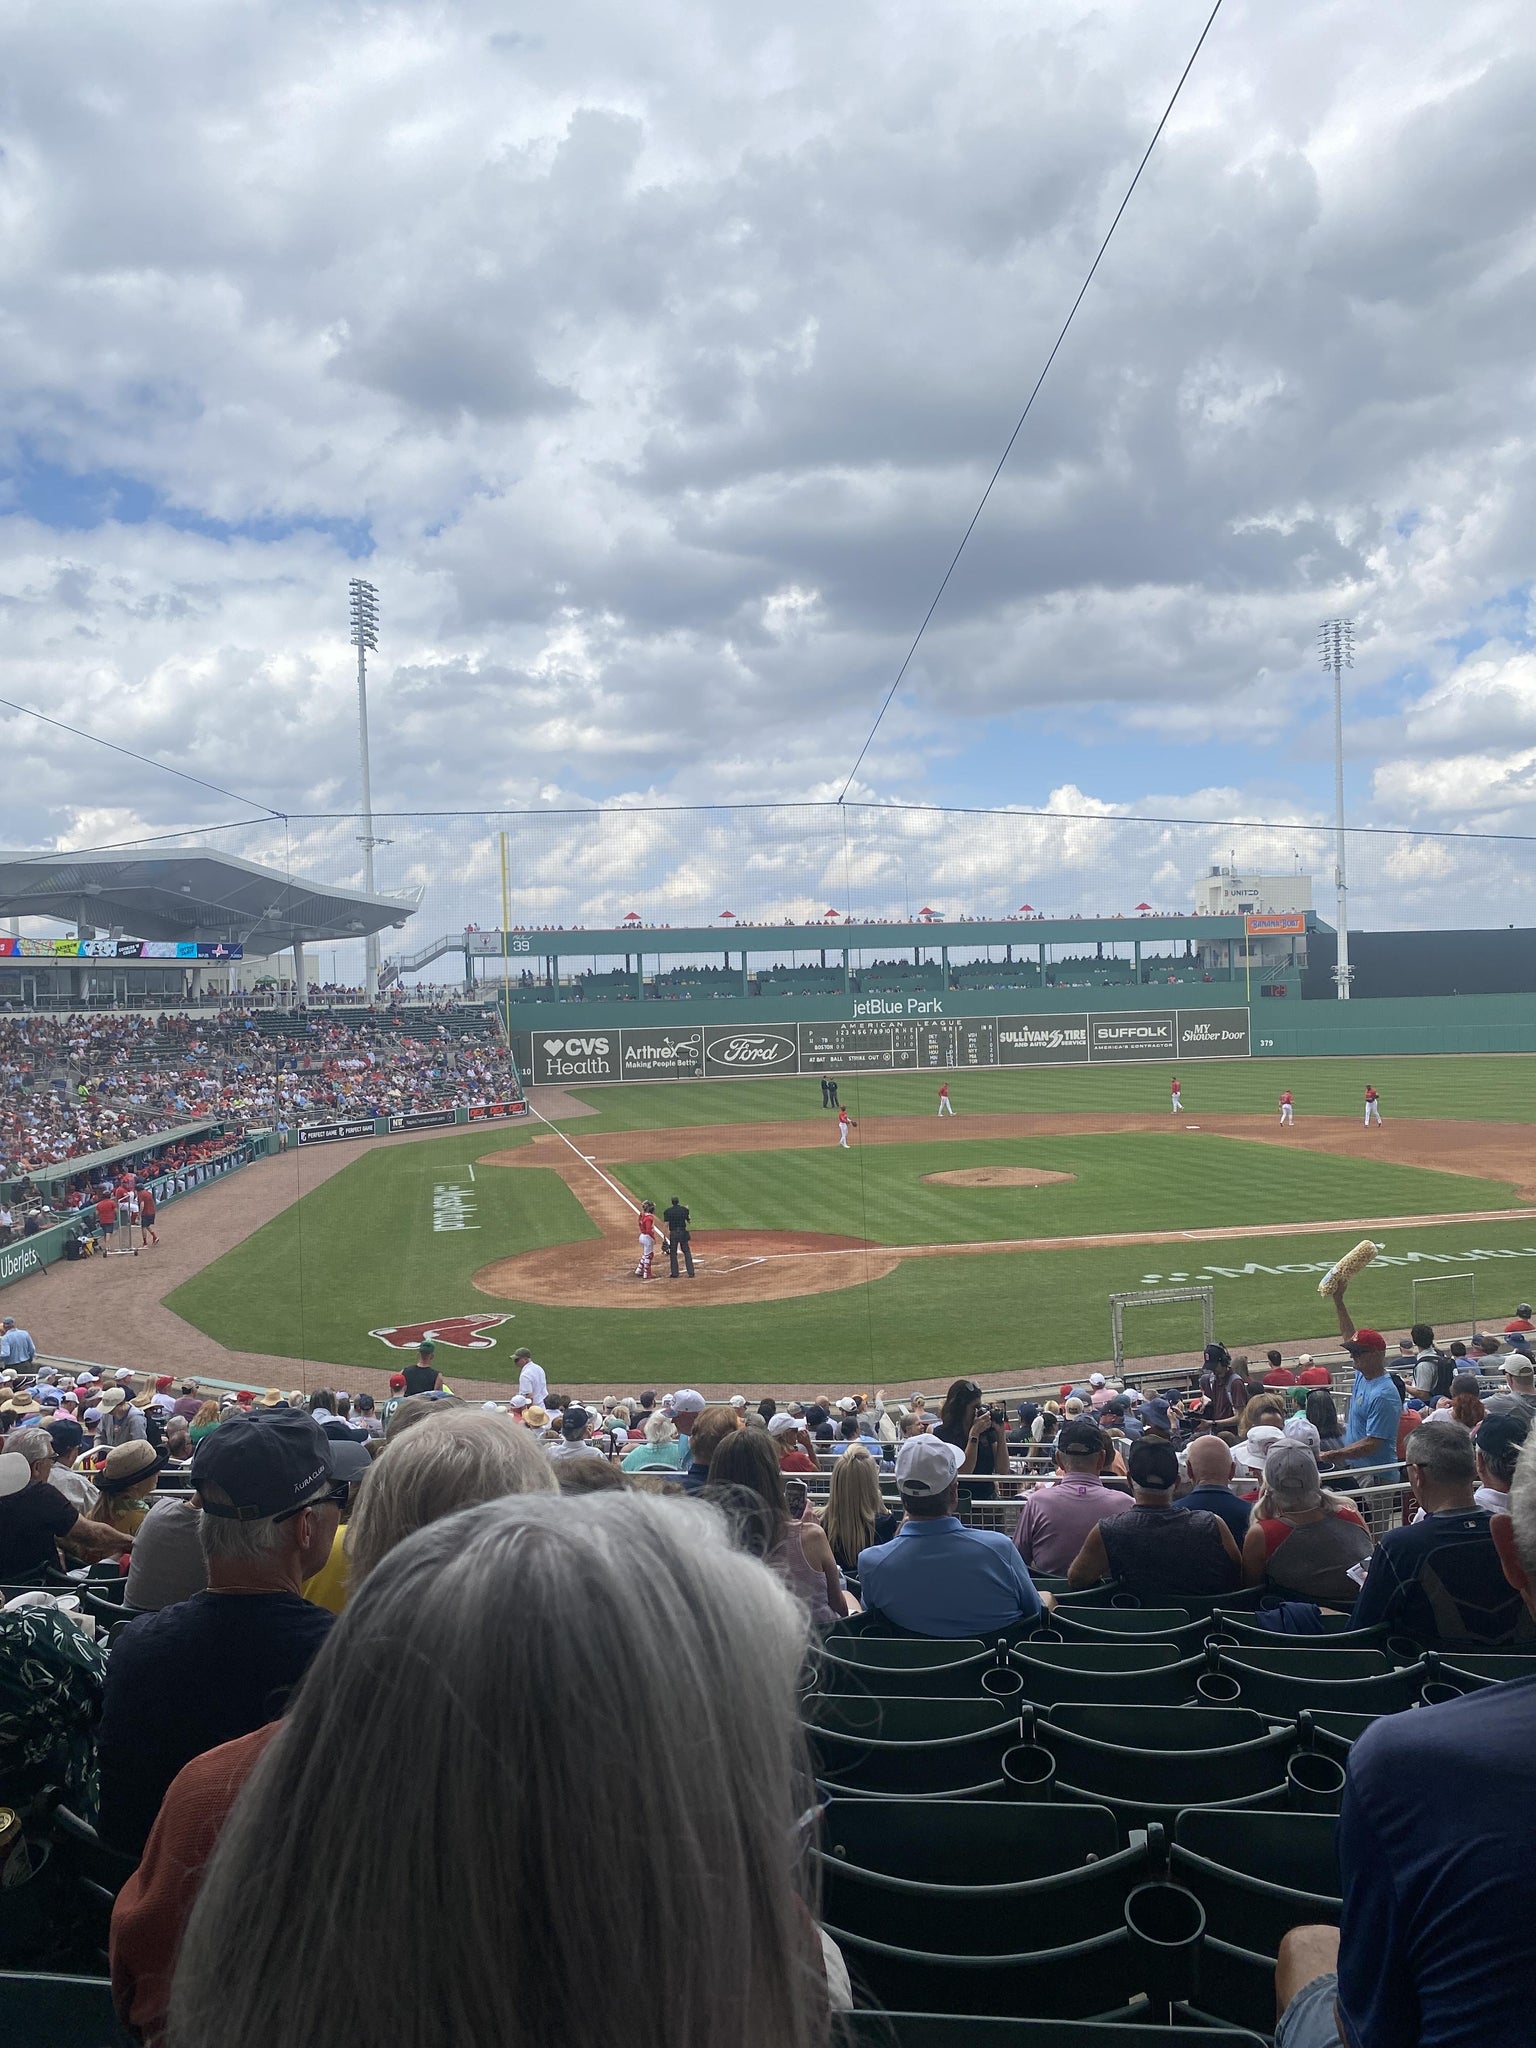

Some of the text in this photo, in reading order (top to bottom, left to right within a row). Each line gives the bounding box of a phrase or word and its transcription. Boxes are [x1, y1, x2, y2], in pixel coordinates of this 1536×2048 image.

[513, 940, 530, 951] 39
[852, 997, 944, 1018] jetBlue Park
[840, 1021, 903, 1029] AMERICAN
[1194, 1023, 1211, 1034] MY
[999, 1029, 1087, 1043] SULLIVAN TIRE
[1097, 1026, 1168, 1039] SUFFOLK
[1182, 1030, 1246, 1042] Shower Door
[565, 1037, 610, 1056] CVS
[1260, 1039, 1274, 1047] 379
[625, 1045, 680, 1060] Arthrex
[724, 1038, 779, 1062] Ford
[546, 1057, 611, 1076] Health
[625, 1060, 652, 1069] Making
[652, 1060, 676, 1069] People
[469, 1108, 485, 1117] DEX
[489, 1105, 505, 1114] DEX
[508, 1103, 524, 1112] DEX
[307, 1131, 326, 1139] PERFECT
[345, 1126, 362, 1134] PERFECT
[1, 1247, 37, 1278] UberJets
[385, 1401, 398, 1417] 19
